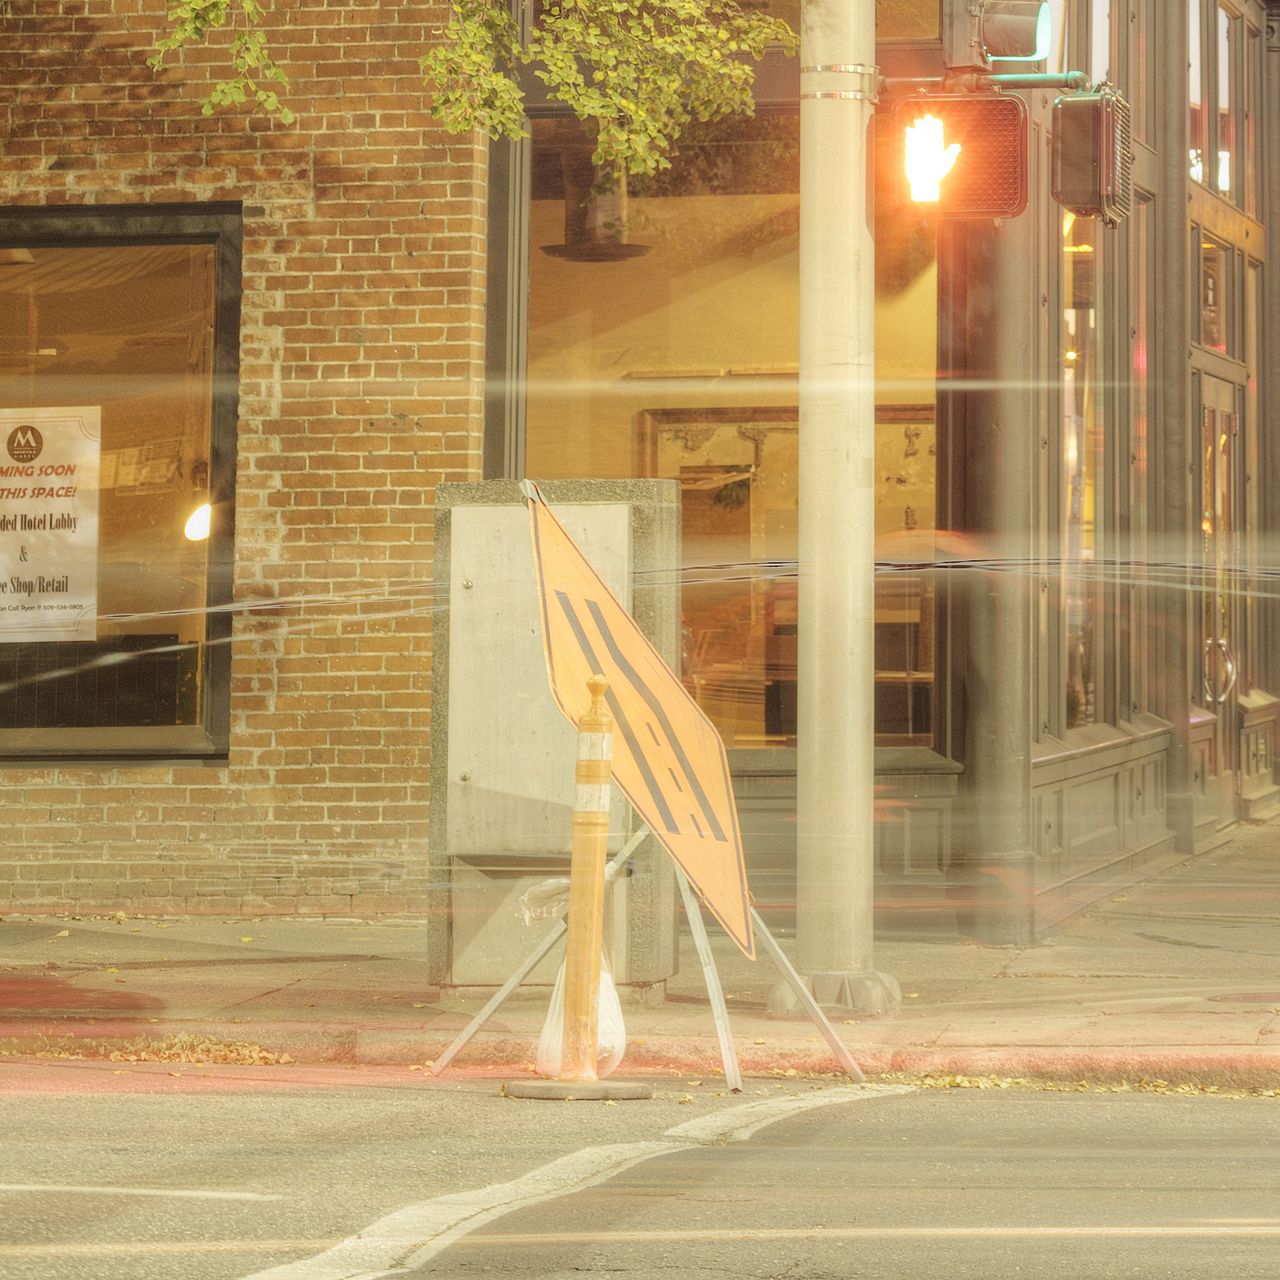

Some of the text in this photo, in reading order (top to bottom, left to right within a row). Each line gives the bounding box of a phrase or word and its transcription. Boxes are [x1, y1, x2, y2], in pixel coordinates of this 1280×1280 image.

[37, 464, 77, 477] SOON
[0, 486, 78, 500] THIS SPACE!
[20, 514, 46, 531] Hotel
[49, 513, 78, 534] Lobby
[19, 545, 28, 562] &
[10, 575, 69, 597] Shop/Retail
